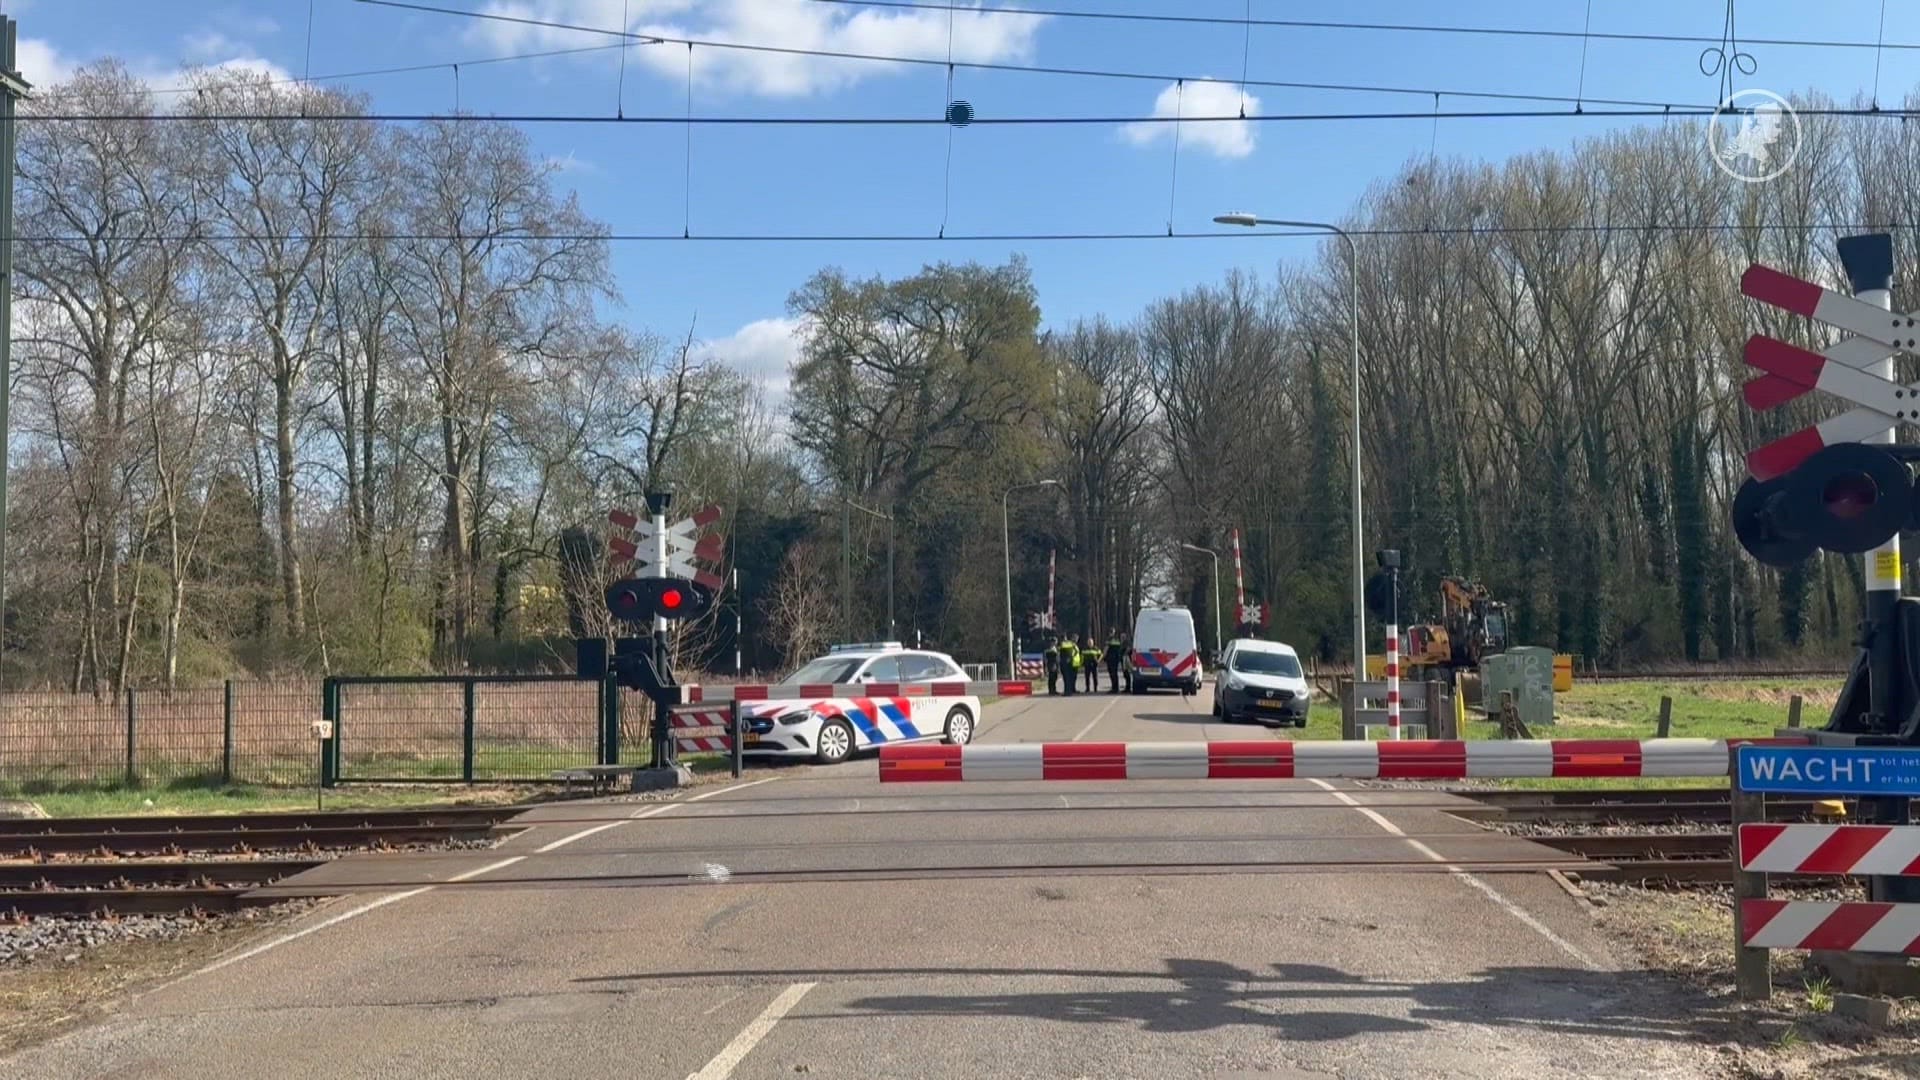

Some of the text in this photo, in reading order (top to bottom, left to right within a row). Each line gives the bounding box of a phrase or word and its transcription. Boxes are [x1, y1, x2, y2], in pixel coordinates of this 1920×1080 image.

[1880, 757, 1920, 767] tot het
[1750, 756, 1876, 782] WACHT
[1881, 775, 1918, 784] er kan
